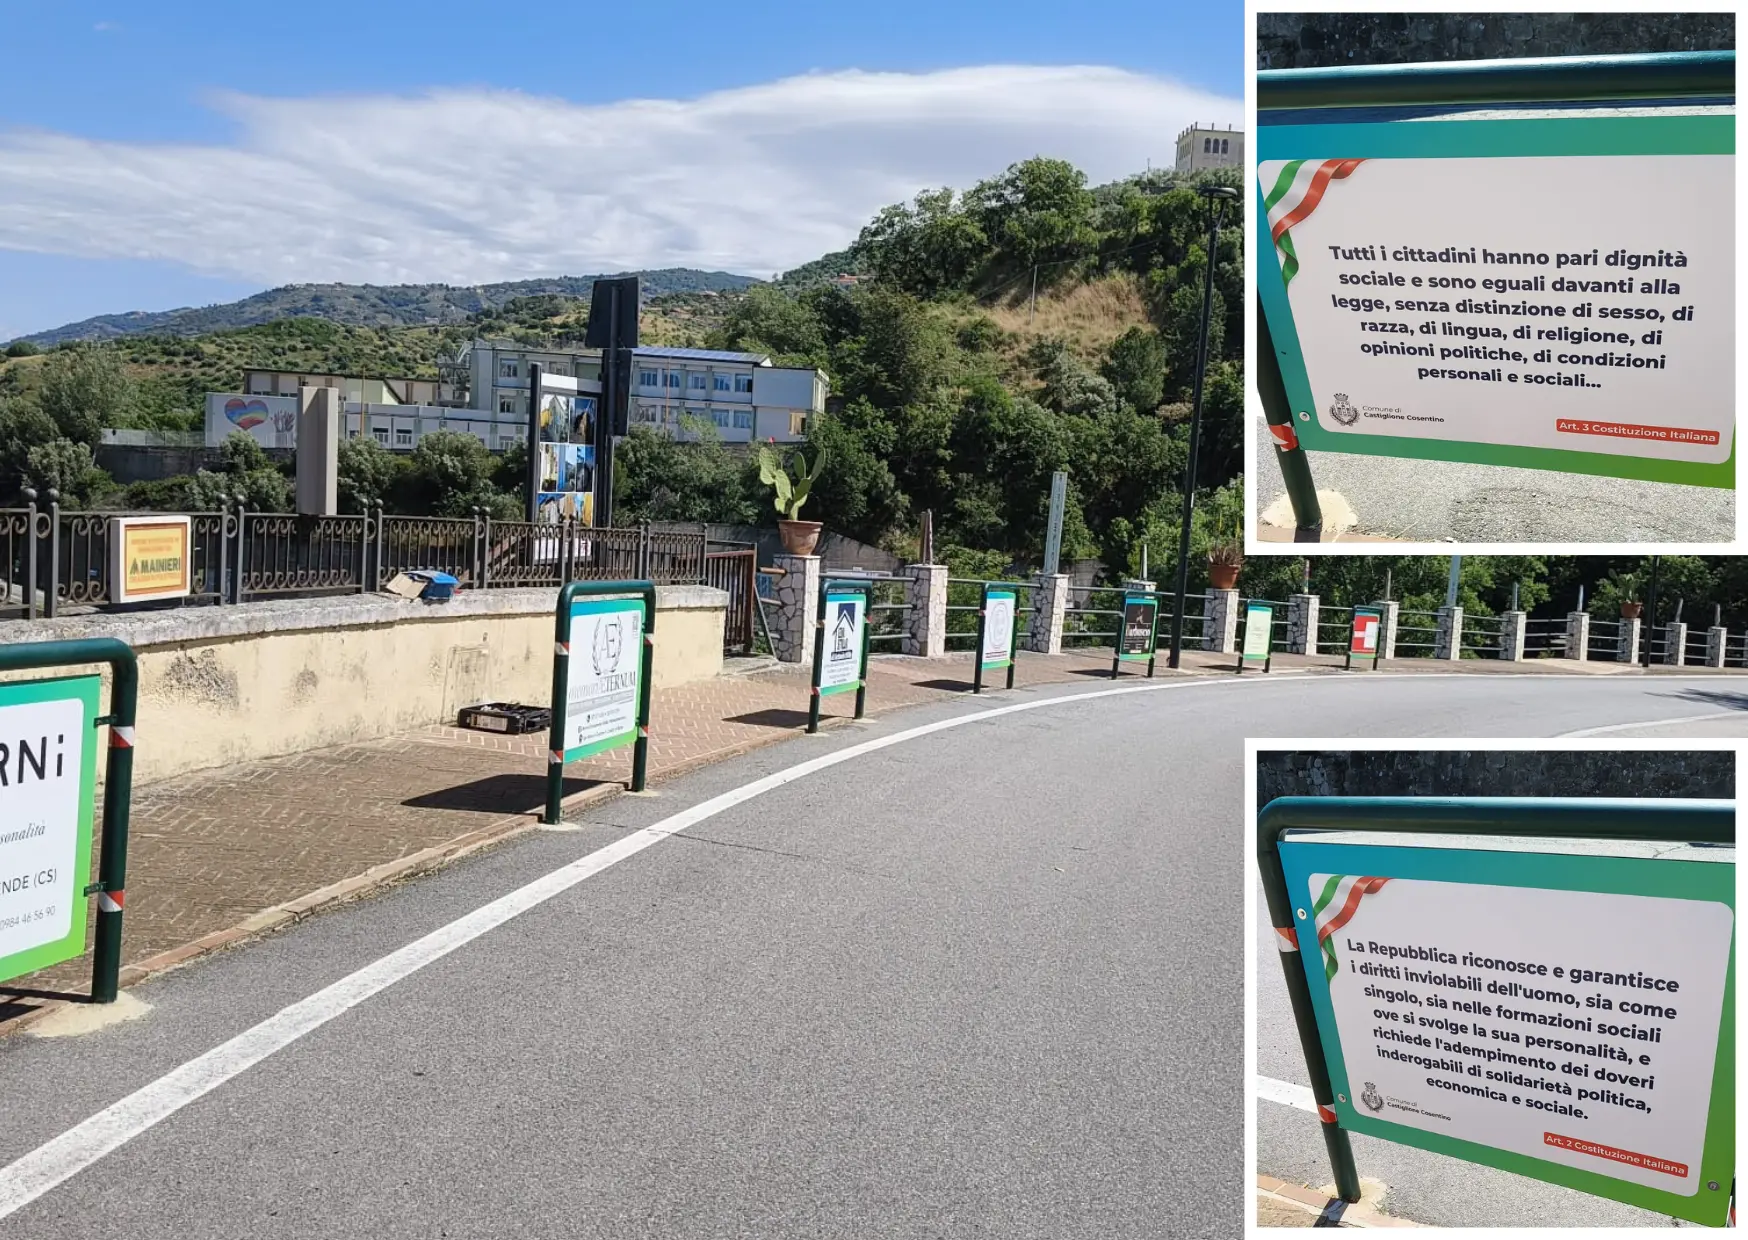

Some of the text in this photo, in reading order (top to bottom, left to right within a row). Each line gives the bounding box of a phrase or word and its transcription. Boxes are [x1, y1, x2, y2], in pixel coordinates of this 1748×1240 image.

[1328, 245, 1688, 271] Tutti i cittadini hanno pari dignità
[1338, 270, 1680, 295] sociale e sono eguali davanti alla
[1331, 294, 1694, 323] legge, senza distinzione di sesso, di
[1360, 320, 1663, 347] razza, di lingua, di religione, di
[1360, 340, 1666, 369] opinioni politiche, di condizioni
[1417, 368, 1602, 388] personali e sociali...
[1362, 405, 1394, 413] Comune
[1364, 412, 1444, 422] Castiglione Cosentino
[1559, 422, 1716, 442] Art. 3 Costituzione Italiana
[140, 556, 180, 574] MAINIERI
[0, 734, 64, 787] RNi
[0, 868, 57, 894] NDE (CS)
[1347, 938, 1680, 993] La Repubblica riconosce e garantisce
[1350, 959, 1677, 1020] i diritti inviolabili dell'uomo, sia come
[1364, 984, 1662, 1043] singolo, sia nelle formazioni sociali
[1373, 1009, 1651, 1066] ove si svolge la sua personalità, e
[1373, 1026, 1655, 1090] richiede l'adempimento dei doveri
[1376, 1044, 1652, 1114] inderogabili di solidarietà politica,
[1426, 1077, 1589, 1120] economica e sociale.
[1546, 1135, 1564, 1146] Art.
[1574, 1142, 1640, 1163] Costituzione
[1643, 1158, 1684, 1174] Italiana
